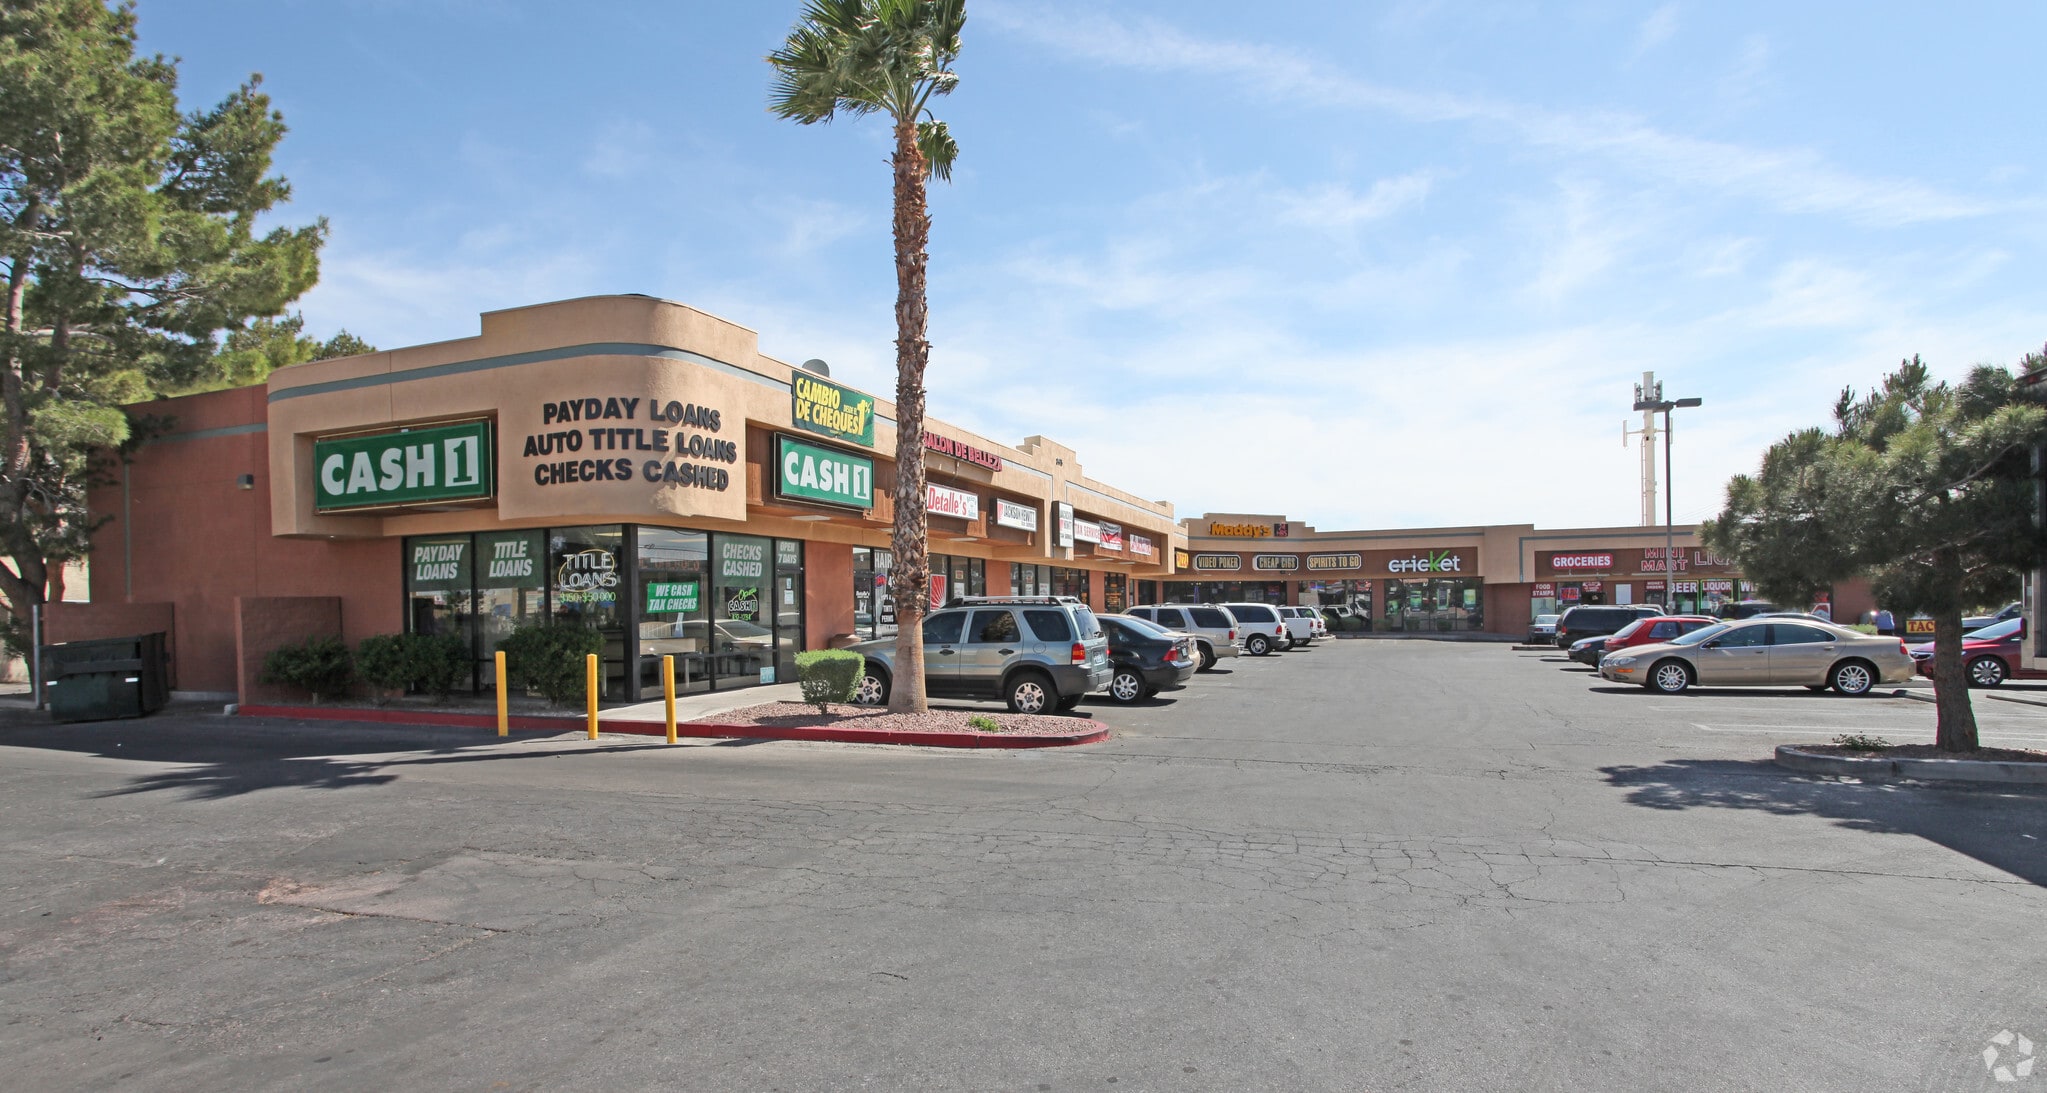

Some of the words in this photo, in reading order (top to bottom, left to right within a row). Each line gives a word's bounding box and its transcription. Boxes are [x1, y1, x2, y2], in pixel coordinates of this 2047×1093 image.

[796, 377, 840, 409] CAMBIO
[543, 397, 640, 425] PAYDAY
[650, 400, 721, 432] LOANS
[795, 398, 811, 422] DE
[812, 404, 860, 435] CHEQUES
[523, 429, 583, 457] AUTO
[589, 428, 669, 451] TITLE
[677, 432, 737, 465] LOANS
[956, 441, 967, 459] DE
[321, 443, 436, 496] CASH
[448, 438, 477, 485] 1
[534, 458, 632, 486] CHECKS
[642, 460, 730, 492] CASHED
[784, 451, 850, 495] CASH
[927, 486, 967, 516] Detalle's
[1211, 523, 1271, 537] Maddy's
[414, 543, 464, 563] PAYDAY
[494, 540, 528, 559] TITLE
[723, 543, 762, 561] CHECKS
[779, 542, 795, 552] OPEN
[1645, 547, 1684, 558] MINI
[562, 551, 615, 571] TITLE
[778, 553, 783, 563] 7
[783, 554, 797, 564] DAYS
[874, 551, 893, 568] HAIR
[1199, 557, 1216, 568] VIDEO
[1219, 557, 1238, 568] POKER
[1259, 557, 1278, 568] CHEAP
[1280, 557, 1295, 568] CIGS
[1310, 556, 1336, 568] SPIRITS
[1338, 556, 1347, 567] TO
[1350, 556, 1359, 567] GO
[1553, 555, 1610, 568] GROCERIES
[416, 562, 457, 581] LOANS
[489, 558, 532, 577] LOANS
[723, 560, 762, 577] CASHED
[560, 571, 617, 588] LOANS
[1672, 582, 1697, 592] BEER
[1702, 582, 1731, 591] LIQUOR
[655, 585, 669, 596] WE
[671, 585, 693, 596] CASH
[649, 599, 666, 611] TAX
[667, 598, 696, 610] CHECKS
[728, 600, 750, 612] CASH
